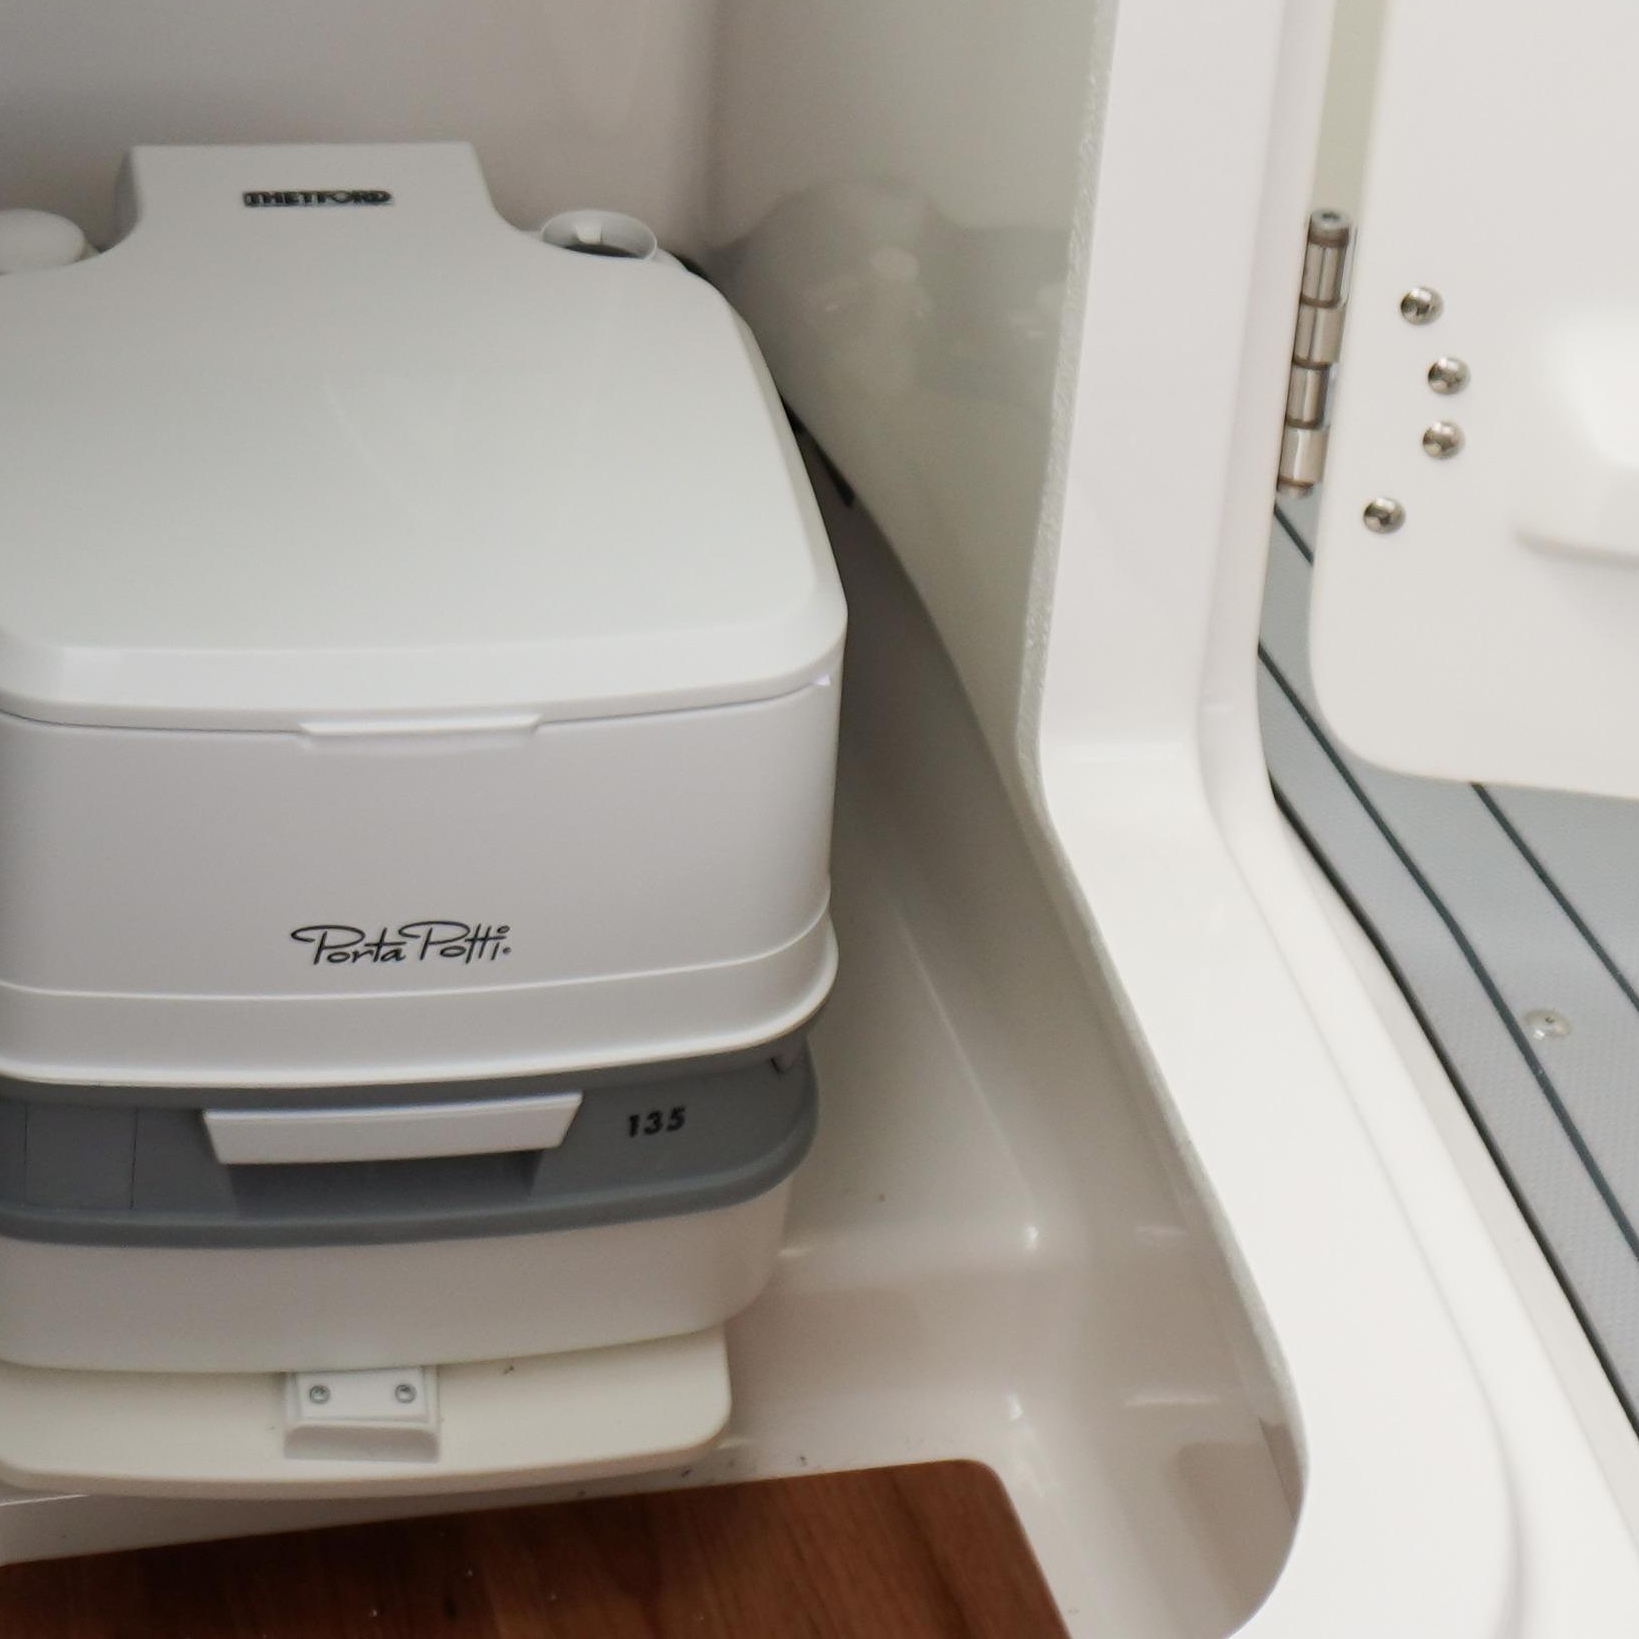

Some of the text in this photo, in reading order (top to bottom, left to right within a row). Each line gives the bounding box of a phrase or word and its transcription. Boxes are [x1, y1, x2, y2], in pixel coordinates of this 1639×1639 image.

[243, 190, 392, 206] THETFORD
[290, 925, 407, 965] Porta
[628, 1106, 686, 1138] 135
